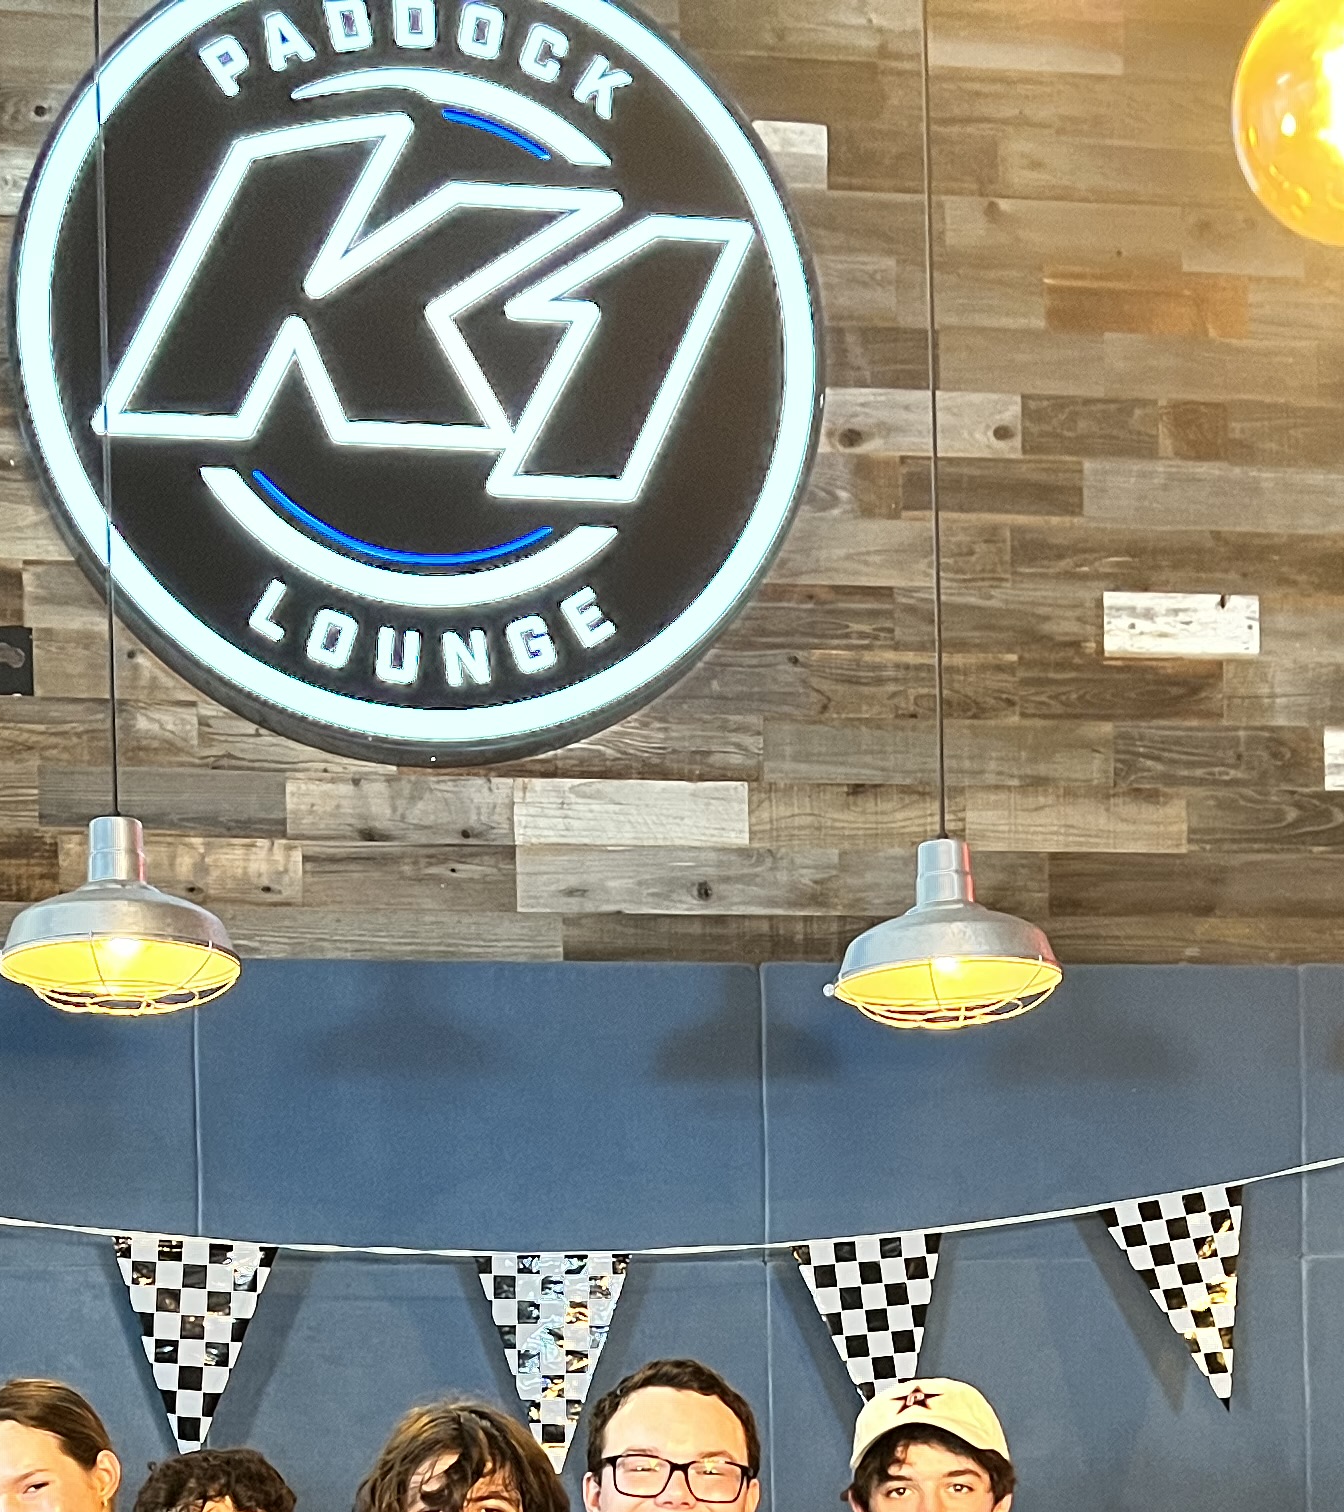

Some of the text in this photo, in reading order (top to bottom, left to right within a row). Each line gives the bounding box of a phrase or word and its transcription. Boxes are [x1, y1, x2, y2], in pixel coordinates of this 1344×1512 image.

[199, 0, 637, 120] PADDOCK
[92, 111, 756, 503] K1
[248, 578, 619, 688] LOUNGE
